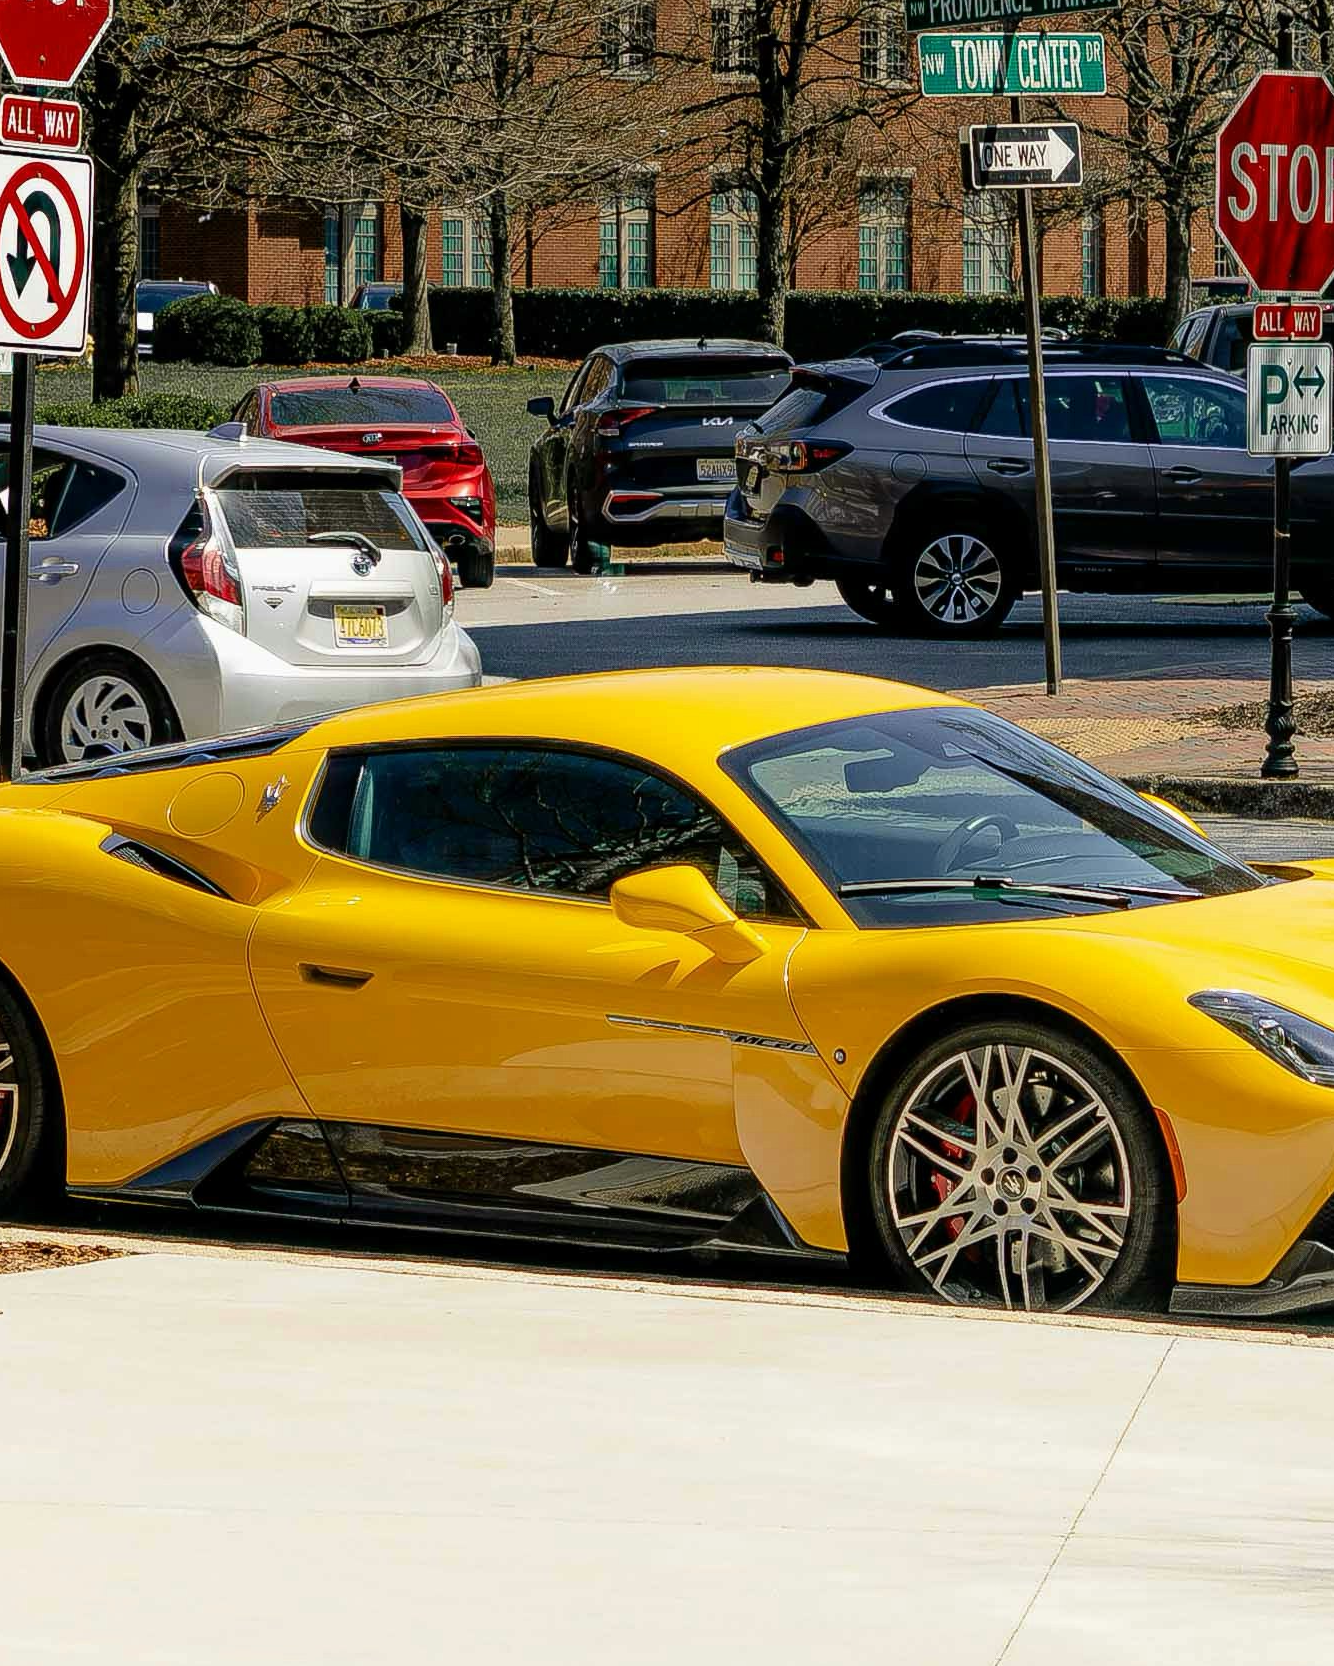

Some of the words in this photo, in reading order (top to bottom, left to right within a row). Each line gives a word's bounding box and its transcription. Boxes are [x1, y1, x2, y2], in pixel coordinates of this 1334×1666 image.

[910, 1, 925, 17] NW
[924, 53, 945, 76] NW
[951, 39, 1009, 90] TOWN
[1018, 39, 1083, 90] CENTER
[1086, 41, 1102, 63] DR
[7, 106, 35, 135] ALL
[44, 109, 75, 139] WAY
[983, 143, 1014, 168] ONE
[1017, 143, 1047, 168] WAY
[1260, 311, 1285, 333] ALL
[1293, 310, 1318, 333] WAY
[735, 1035, 808, 1052] MC20
